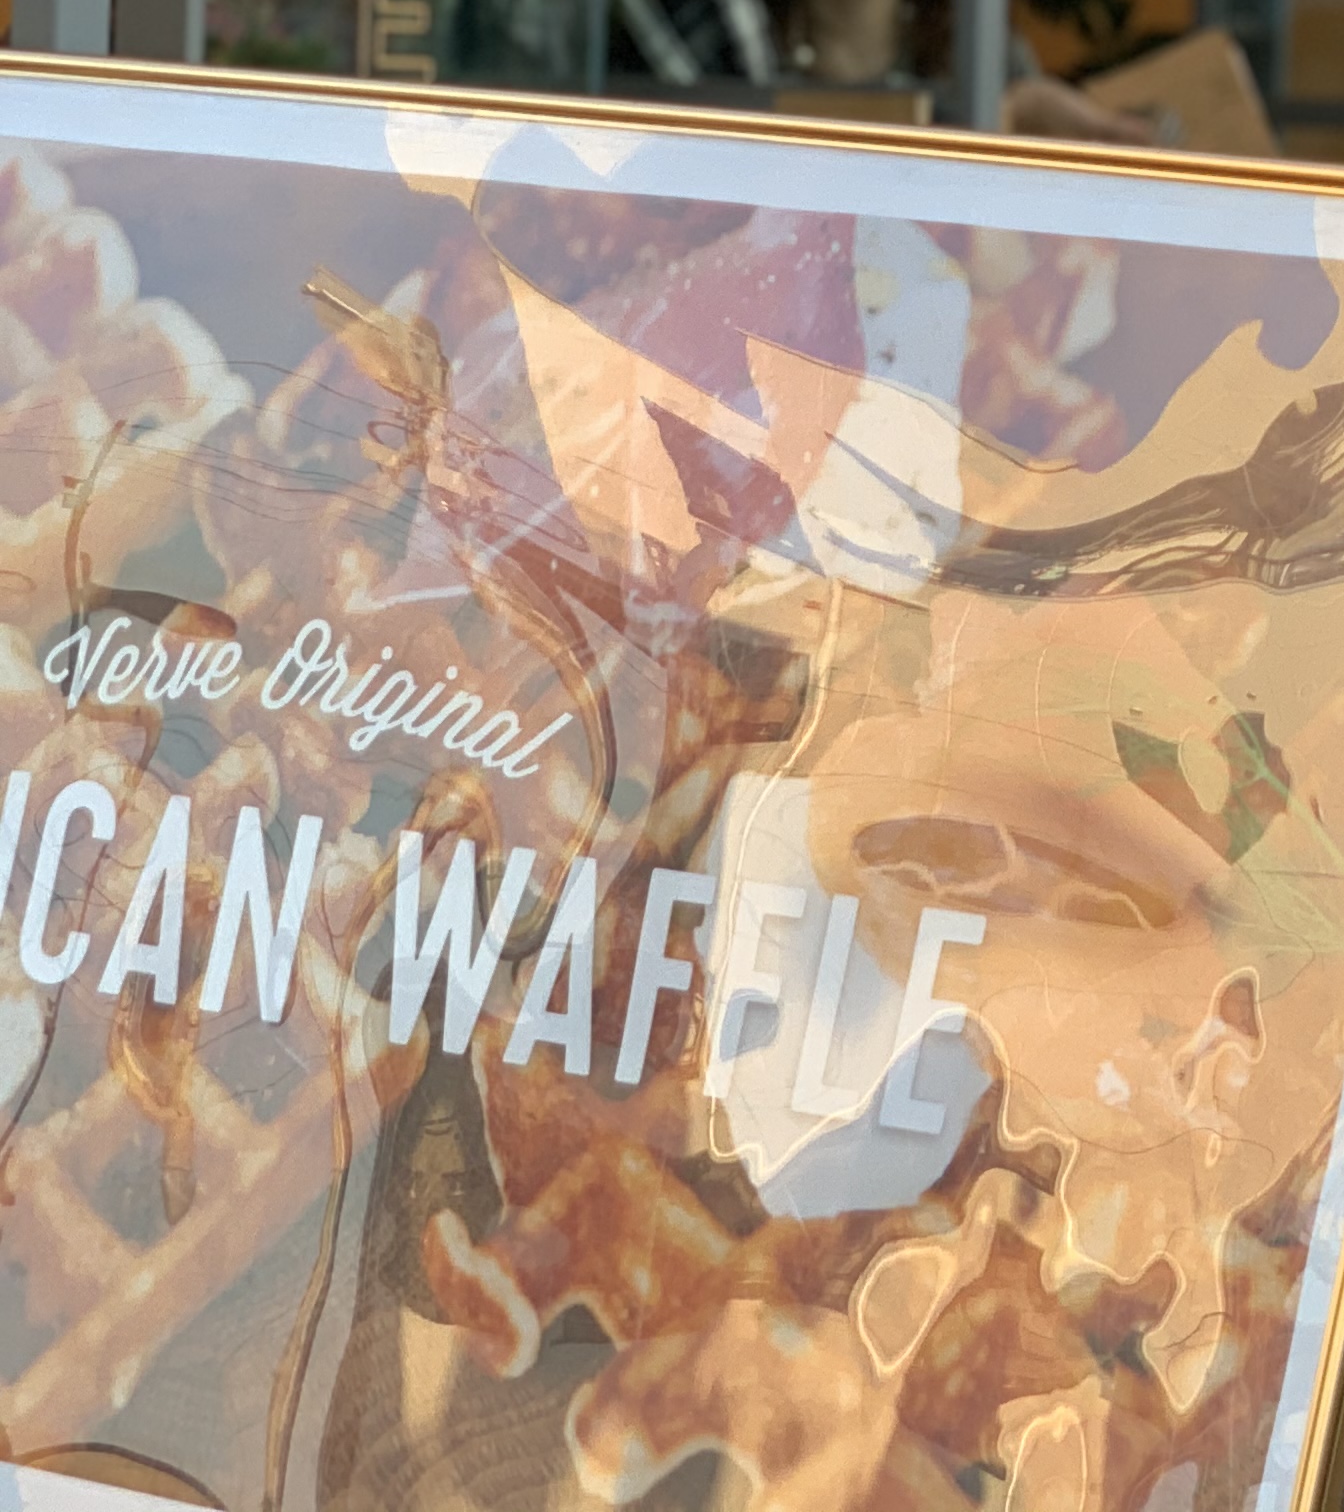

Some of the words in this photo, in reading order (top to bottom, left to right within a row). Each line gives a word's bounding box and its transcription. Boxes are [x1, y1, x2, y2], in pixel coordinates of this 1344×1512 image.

[44, 617, 241, 710] Verve
[259, 618, 573, 780] Original
[387, 829, 987, 1136] WAFFLE
